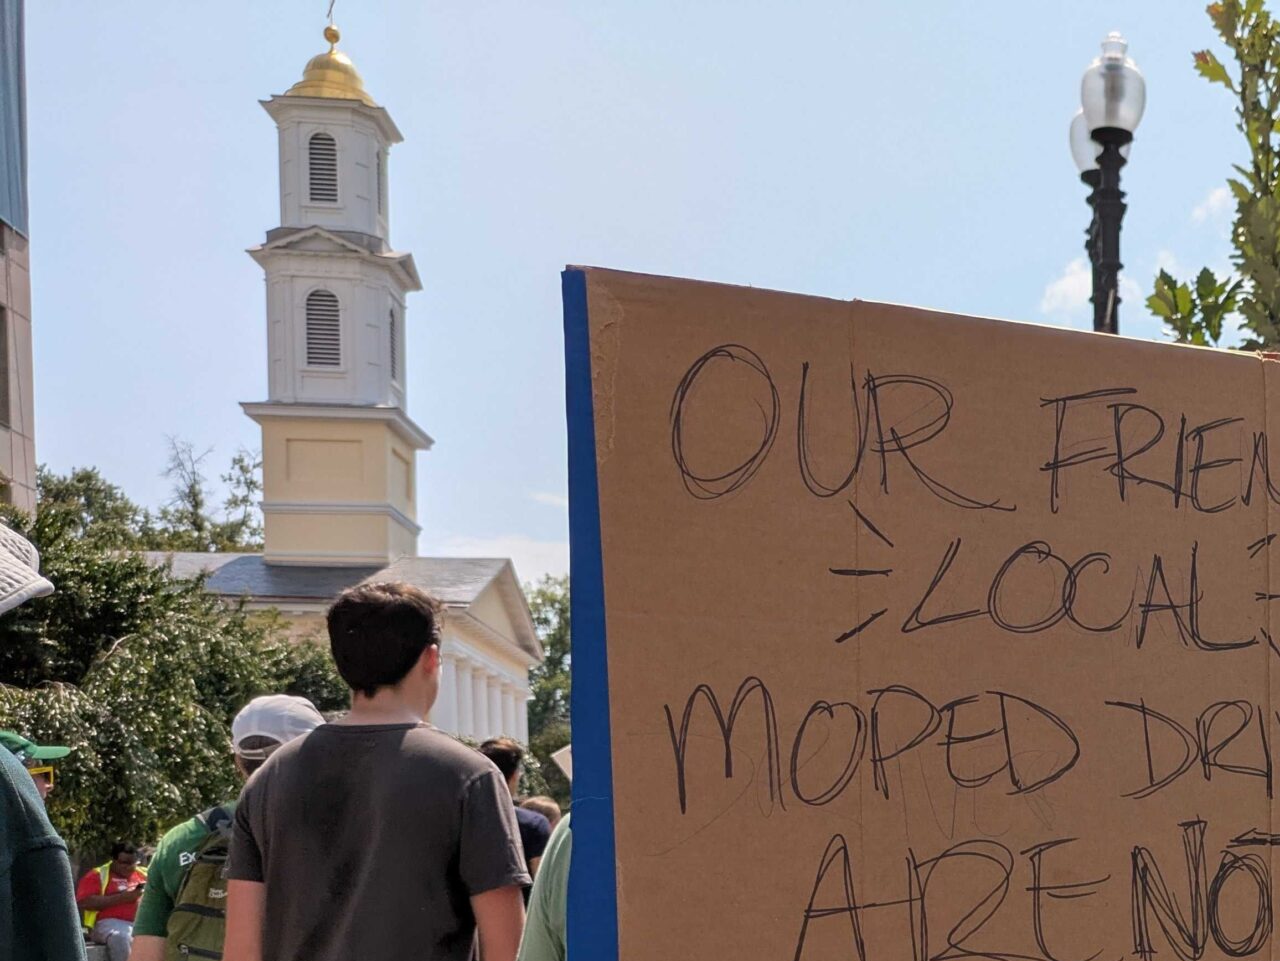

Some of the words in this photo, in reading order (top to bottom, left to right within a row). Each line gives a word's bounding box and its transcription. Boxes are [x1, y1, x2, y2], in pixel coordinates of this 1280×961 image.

[669, 341, 1016, 512] OUR
[901, 539, 1259, 652] LOCAL
[663, 676, 1080, 815] MOPED
